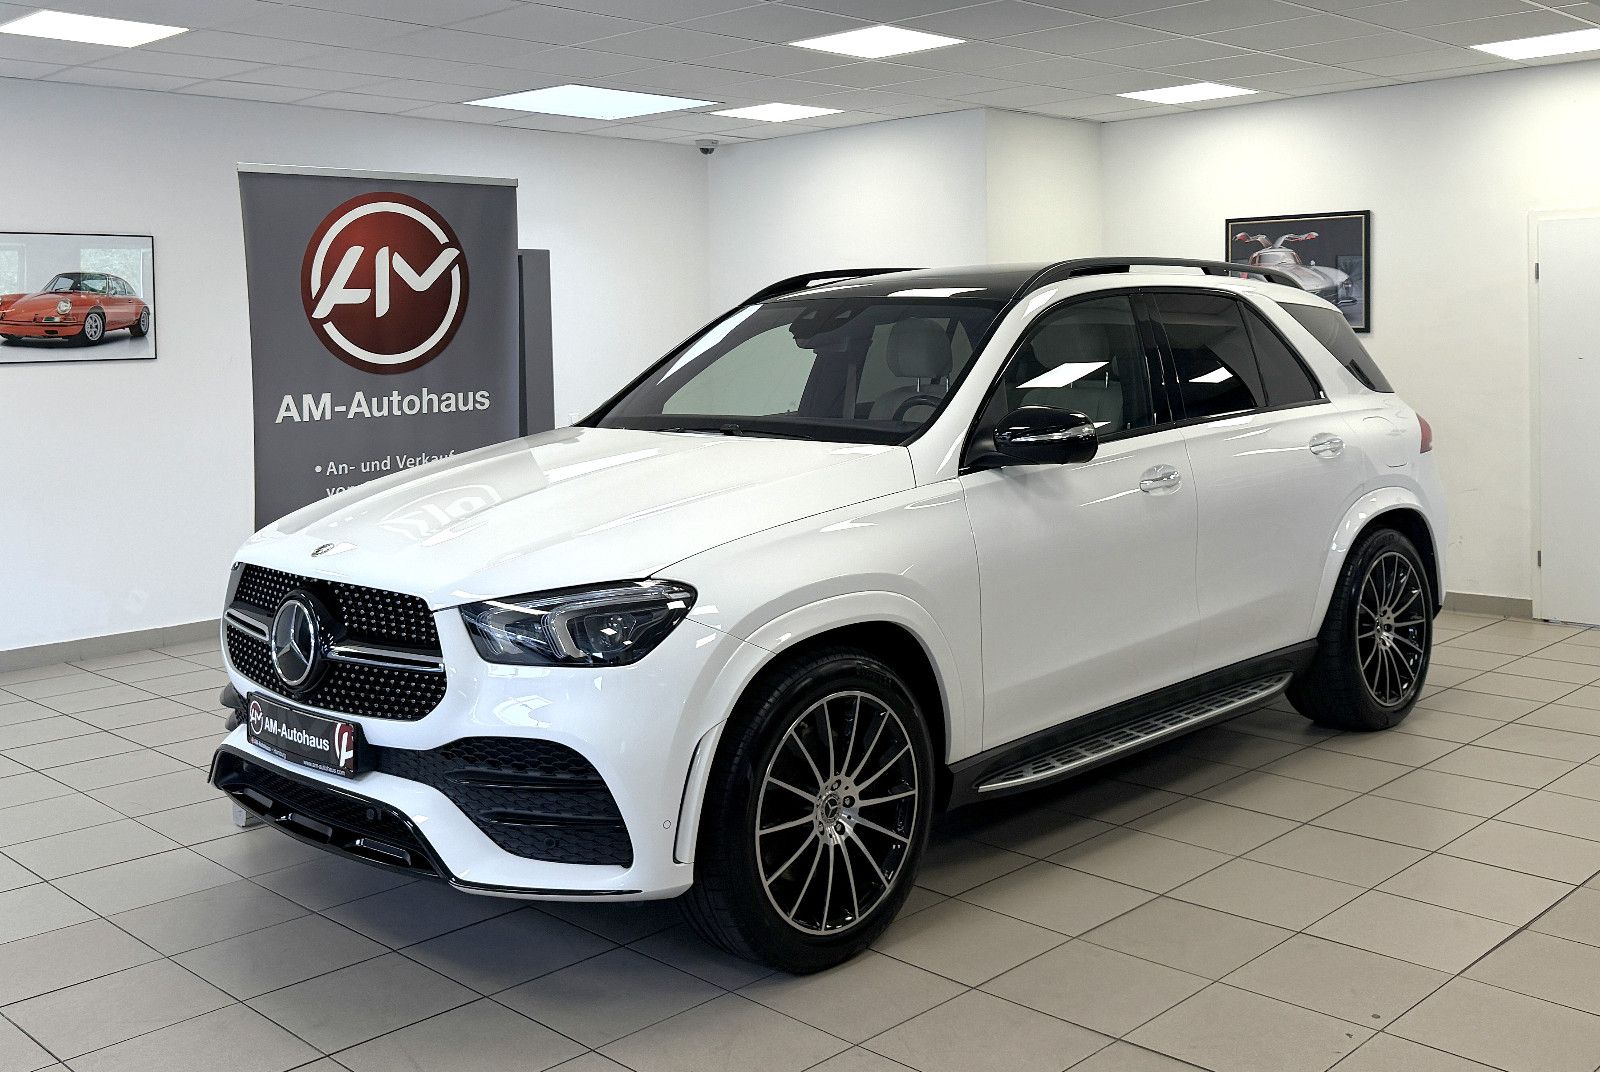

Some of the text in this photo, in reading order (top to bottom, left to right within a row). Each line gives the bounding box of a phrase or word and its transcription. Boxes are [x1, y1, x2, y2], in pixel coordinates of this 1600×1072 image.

[275, 388, 491, 424] AM-Autohaus
[326, 461, 356, 476] An-
[361, 455, 391, 473] und
[326, 486, 356, 497] vo
[264, 716, 330, 752] AM-Autohaus
